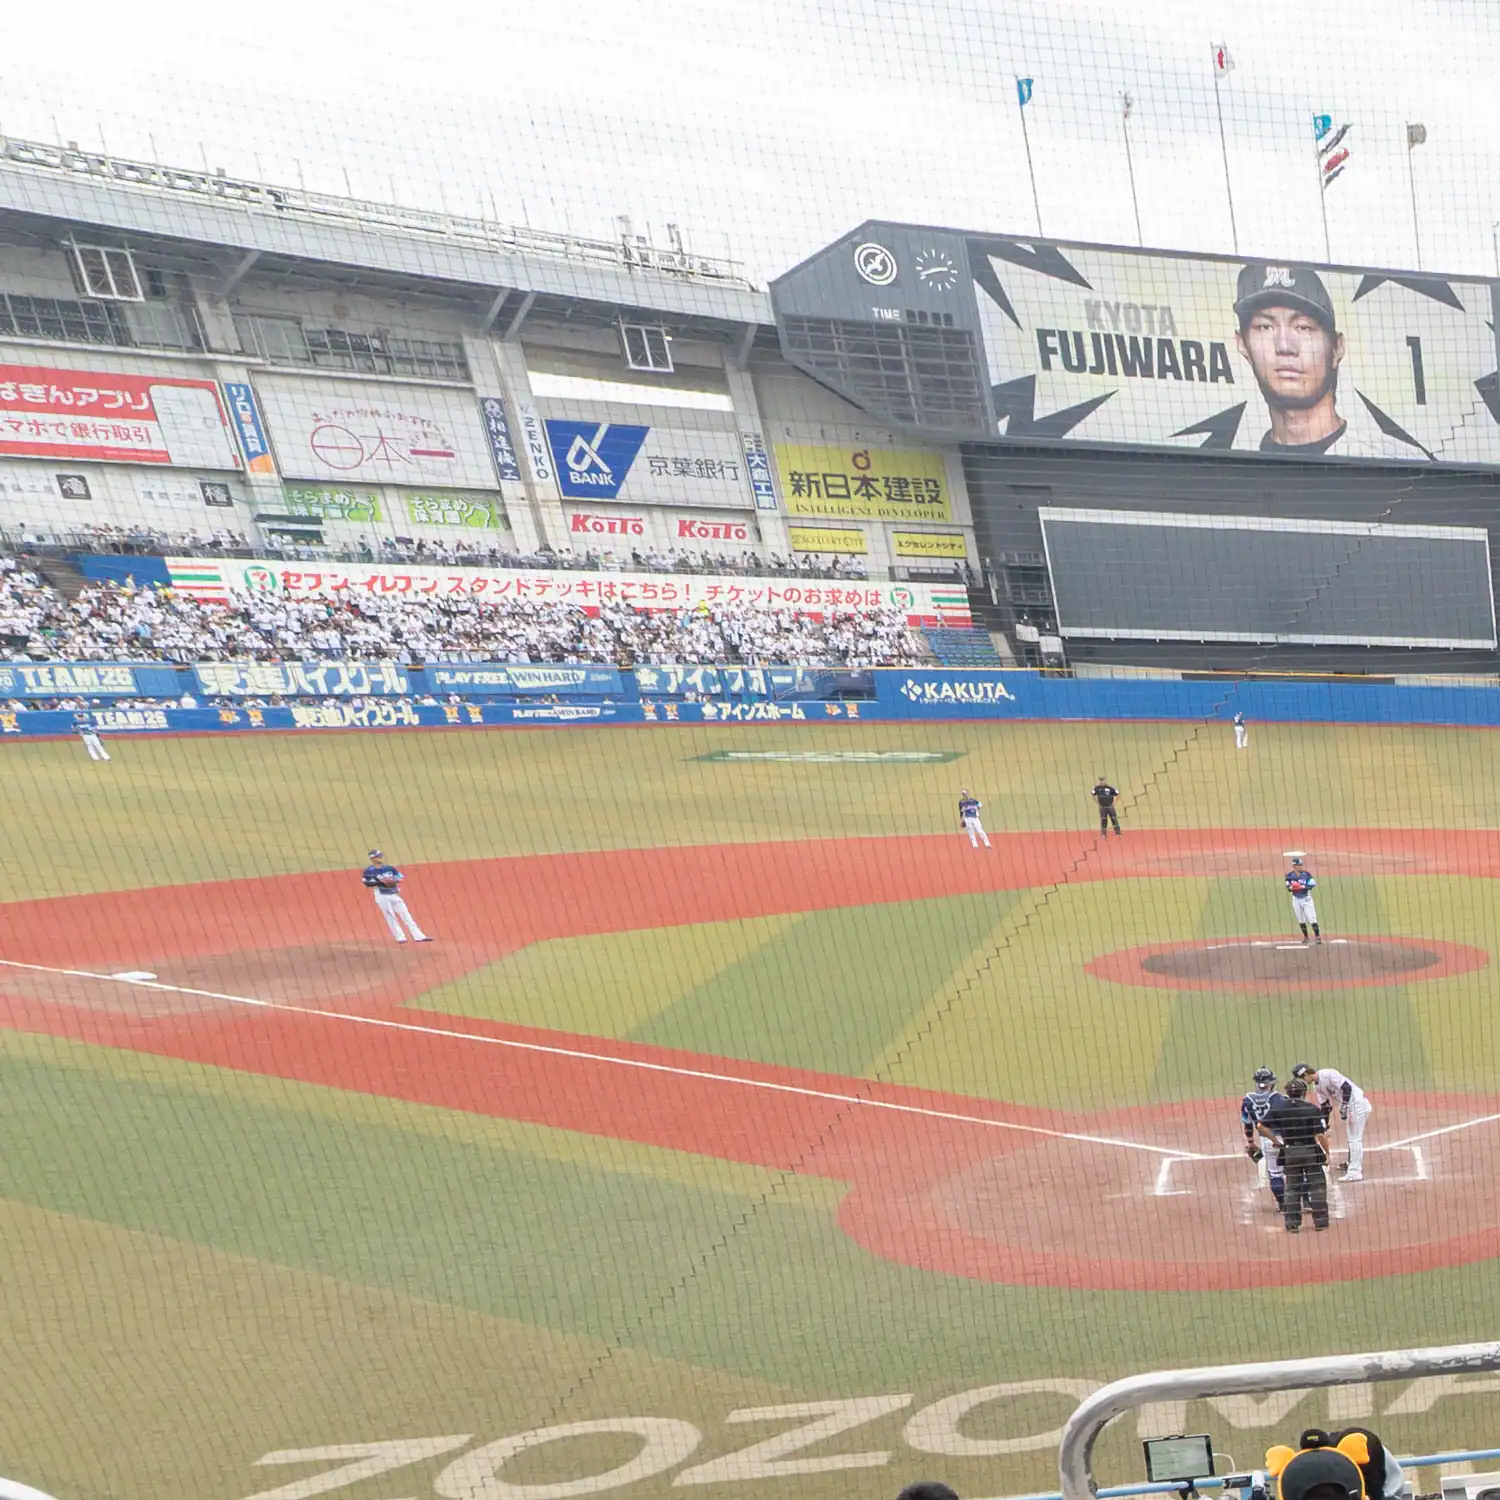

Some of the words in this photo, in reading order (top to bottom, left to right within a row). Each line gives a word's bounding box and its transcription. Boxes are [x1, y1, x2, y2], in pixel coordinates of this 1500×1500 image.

[871, 307, 899, 320] TIME
[1084, 300, 1178, 337] KYOTA
[1036, 328, 1235, 384] FUJIWARA
[1406, 336, 1427, 404] 1
[0, 418, 151, 443] マホで銀行取引
[570, 471, 616, 486] BANK
[647, 455, 738, 481] 京葉銀行
[789, 470, 944, 505] 新日本建設
[706, 583, 882, 608] チケットのお求めは
[923, 681, 1009, 700] KAKUTA
